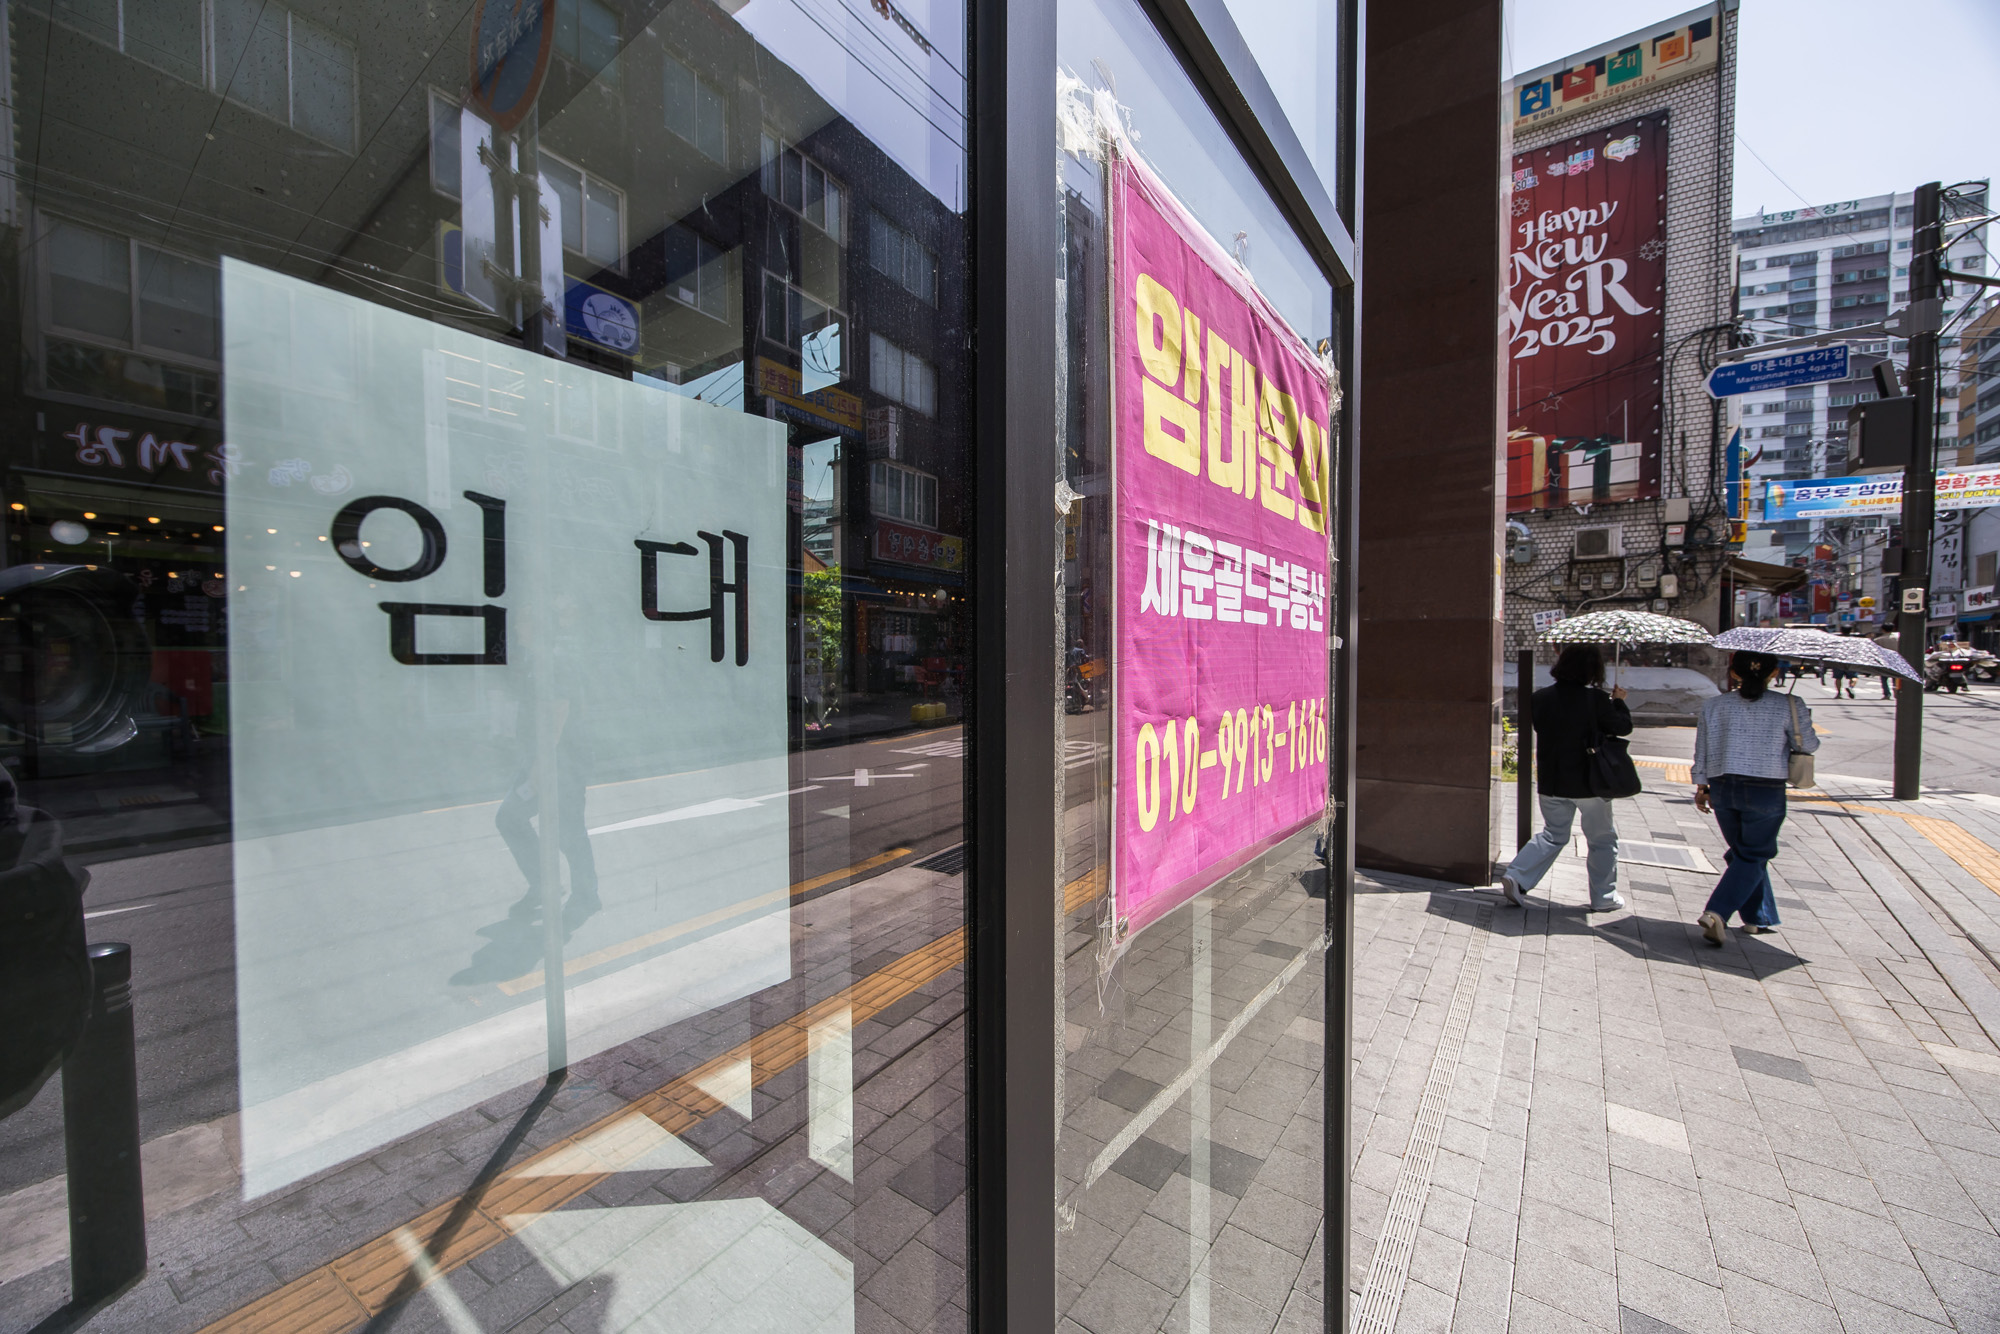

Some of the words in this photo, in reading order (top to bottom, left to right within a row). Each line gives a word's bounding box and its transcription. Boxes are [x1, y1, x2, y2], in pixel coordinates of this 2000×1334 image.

[1517, 200, 1619, 251] Happy
[1509, 232, 1608, 288] New
[1513, 315, 1617, 360] 2025
[1135, 272, 1329, 537] 임대문의
[1795, 486, 1851, 501] 충무로
[1857, 481, 1903, 497] 상인
[1140, 517, 1326, 633] 세운골드부동산
[1135, 697, 1327, 834] 010-9913-1616
